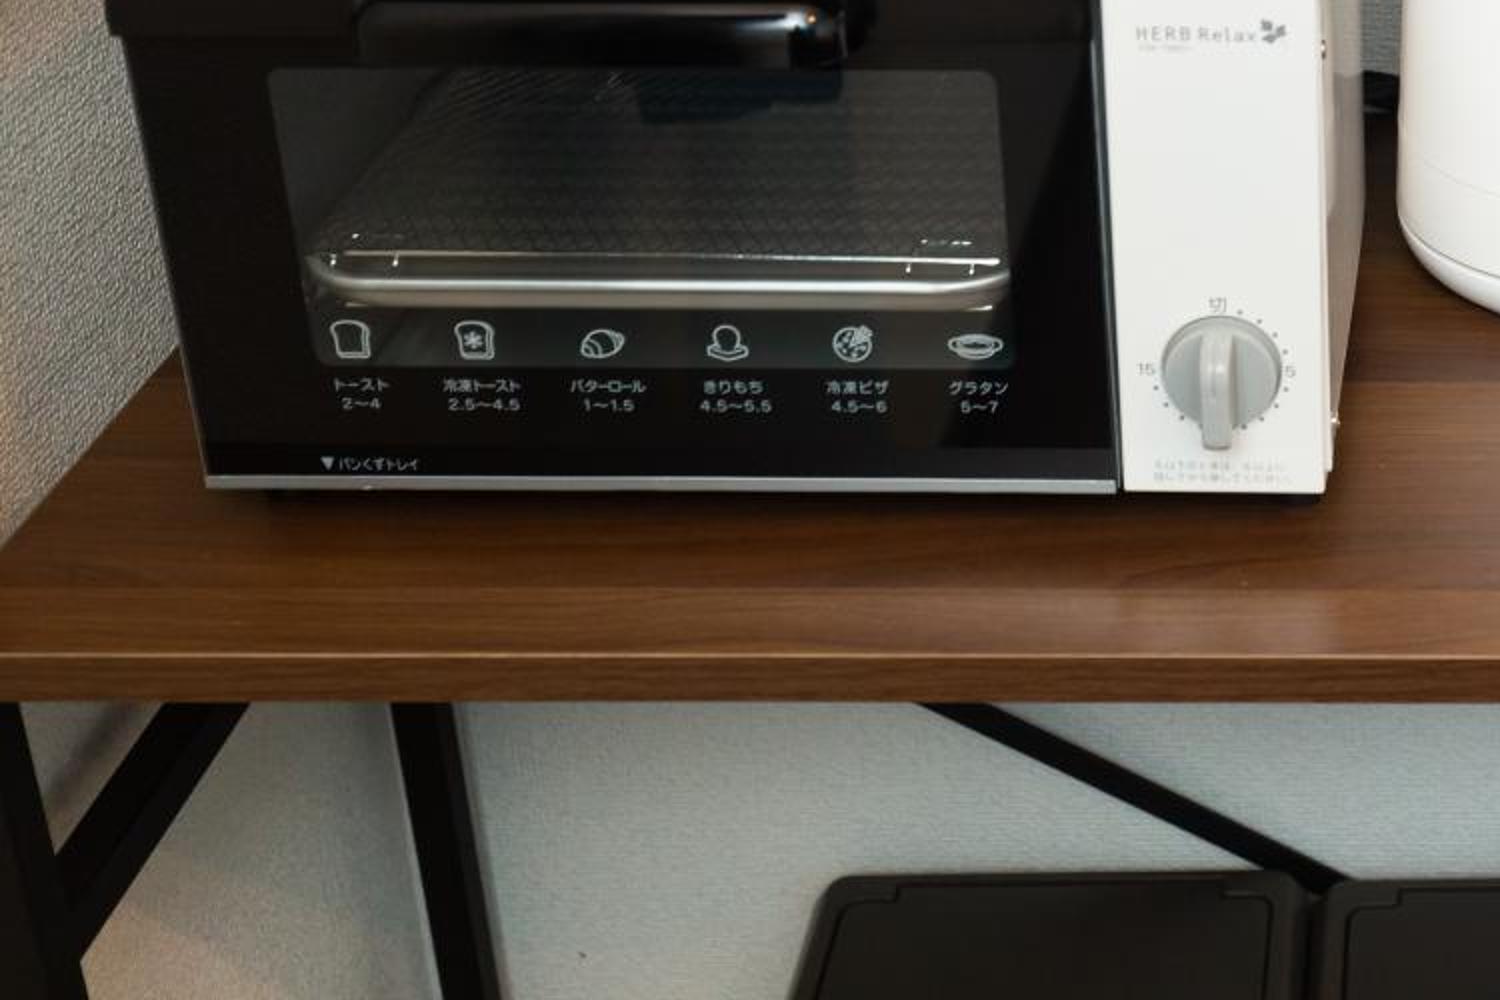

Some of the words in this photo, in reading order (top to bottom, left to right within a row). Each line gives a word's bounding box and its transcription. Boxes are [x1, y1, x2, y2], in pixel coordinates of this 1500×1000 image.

[1136, 26, 1190, 41] HERB
[1198, 26, 1256, 42] Relax
[1136, 363, 1155, 376] 15
[1285, 365, 1296, 378] 5
[333, 377, 390, 392] トースト
[443, 378, 521, 393] 冷凍トースト
[948, 381, 1008, 395] グラタン
